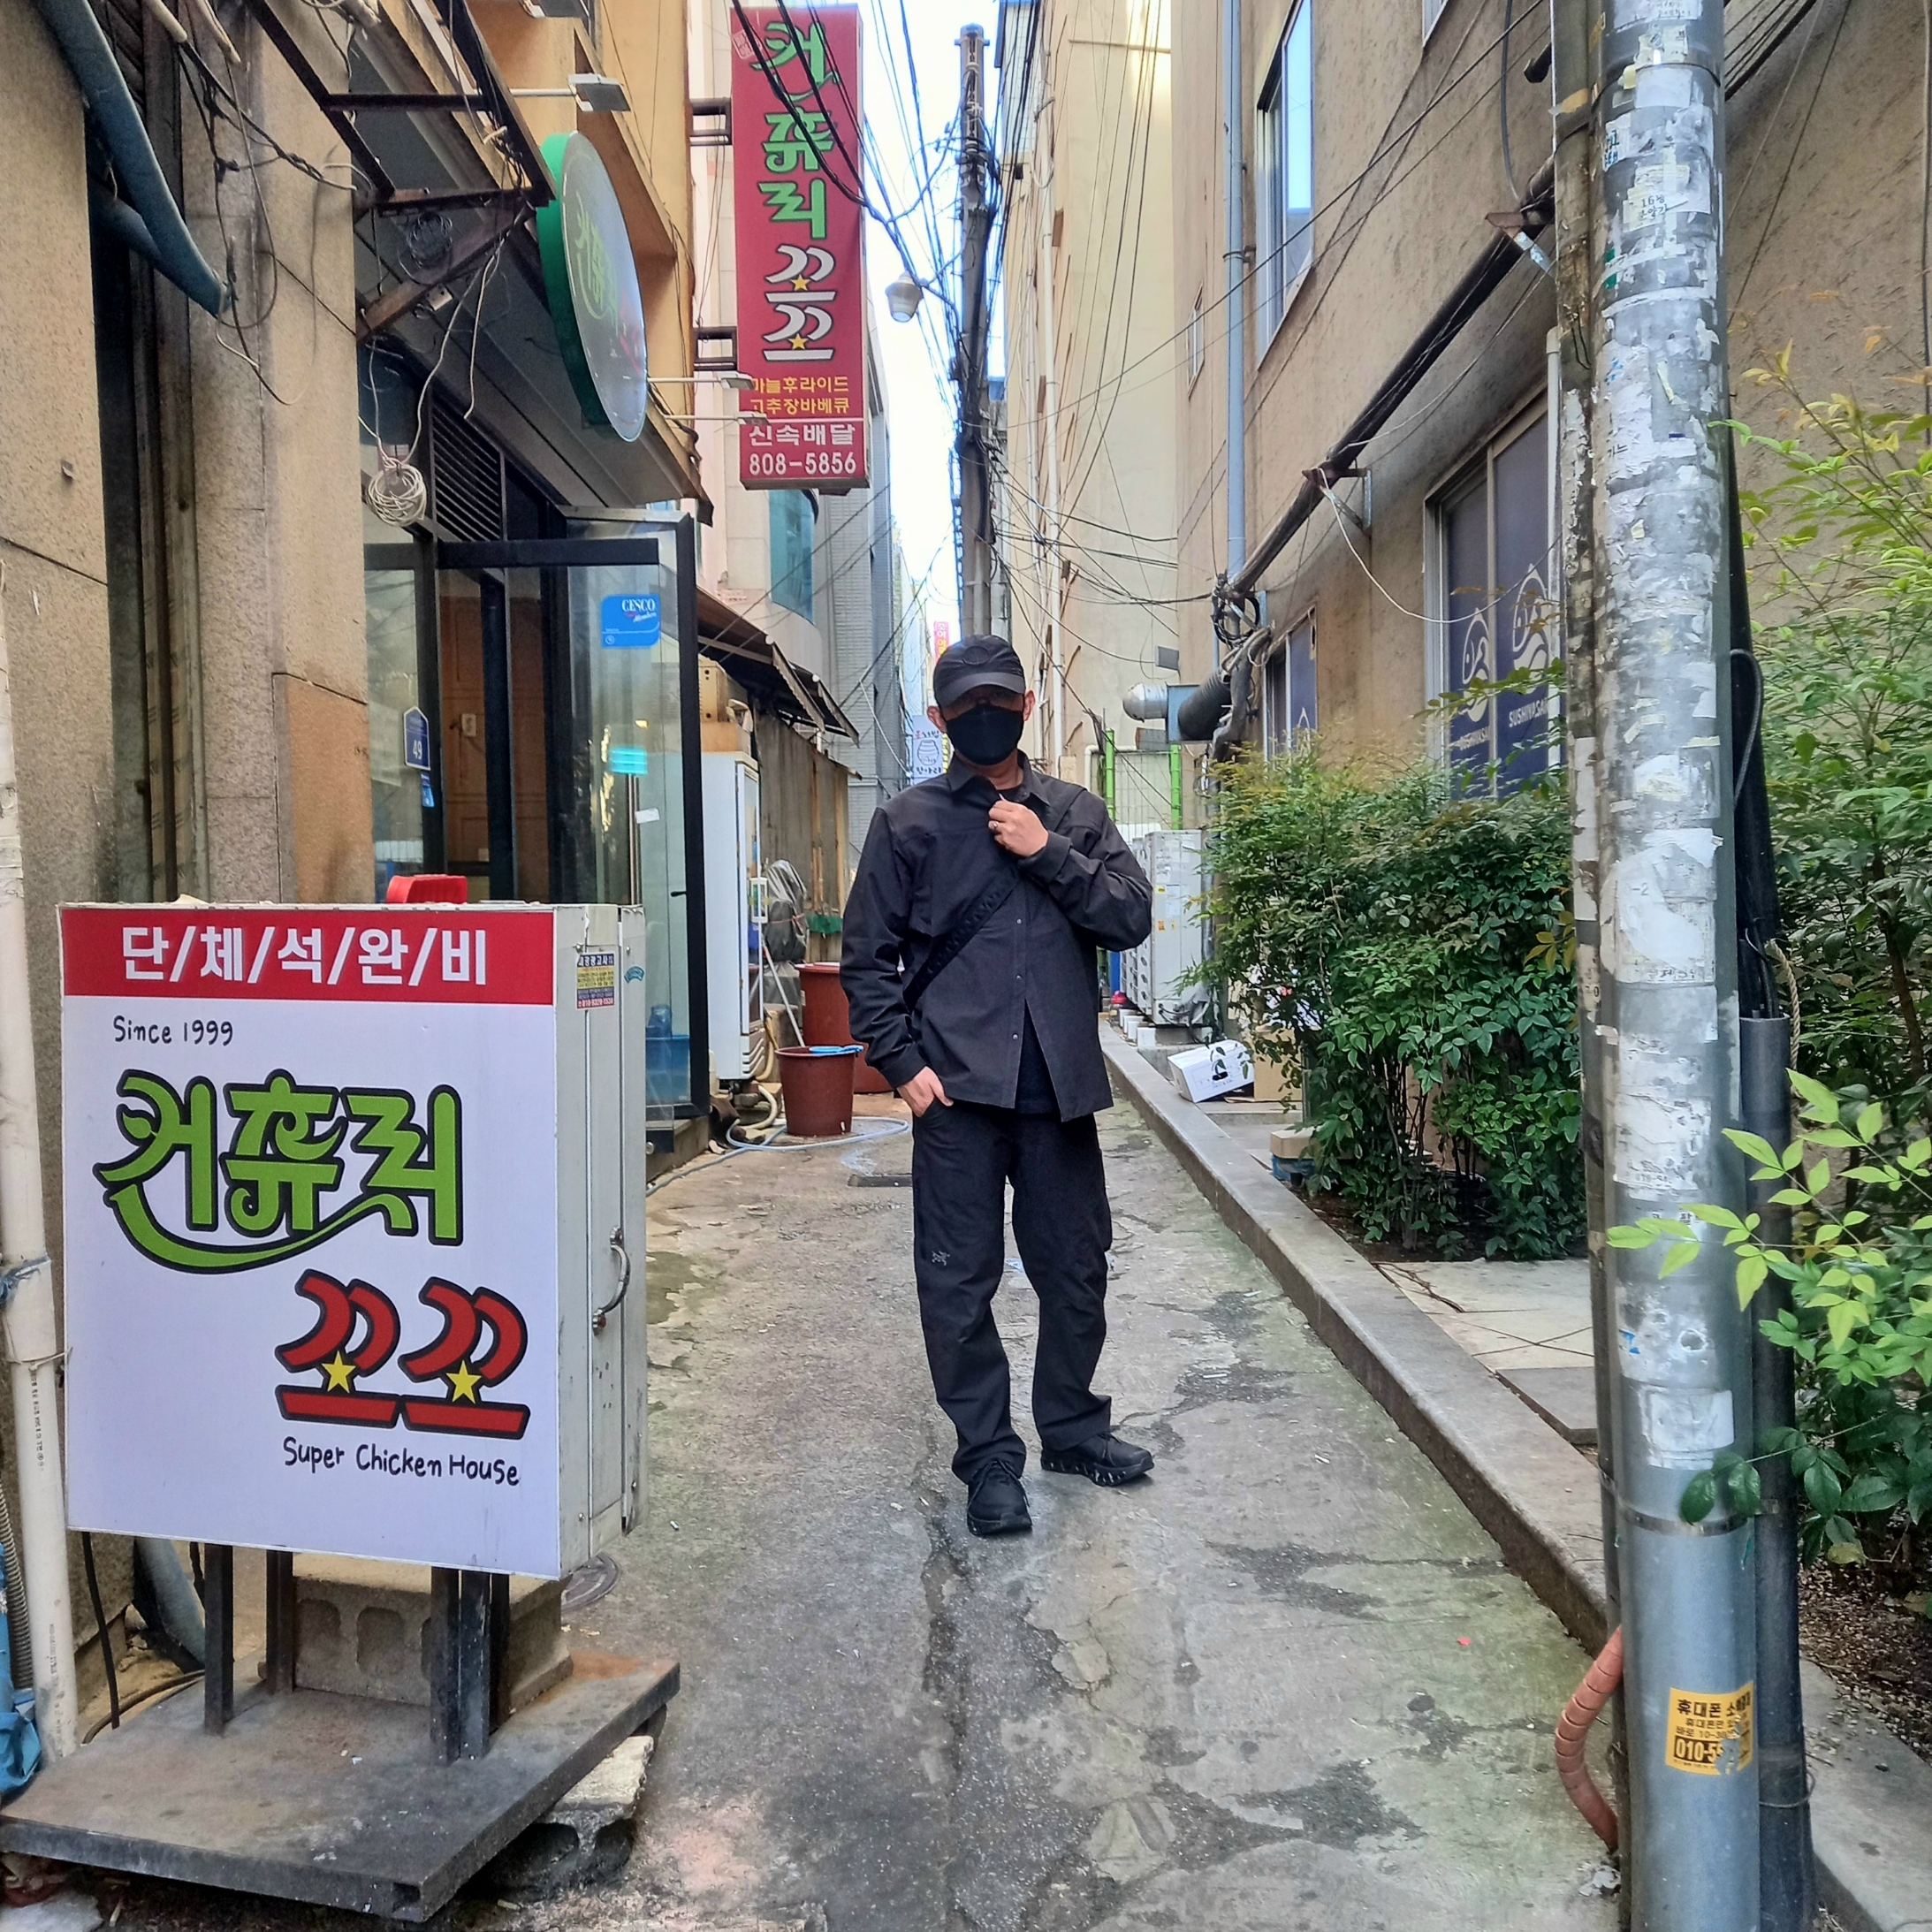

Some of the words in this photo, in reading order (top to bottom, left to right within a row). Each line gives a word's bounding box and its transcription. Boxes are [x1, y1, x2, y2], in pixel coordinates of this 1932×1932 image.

[749, 423, 856, 446] 신속배달
[749, 452, 856, 475] 808-5856
[621, 598, 656, 612] CESCO
[413, 740, 422, 760] 49
[113, 1015, 172, 1045] Since
[183, 1019, 233, 1046] 1999
[283, 1436, 346, 1473] Super
[355, 1443, 442, 1478] Chicken
[448, 1453, 520, 1486] House
[1677, 1699, 1721, 1718] 휴대폰
